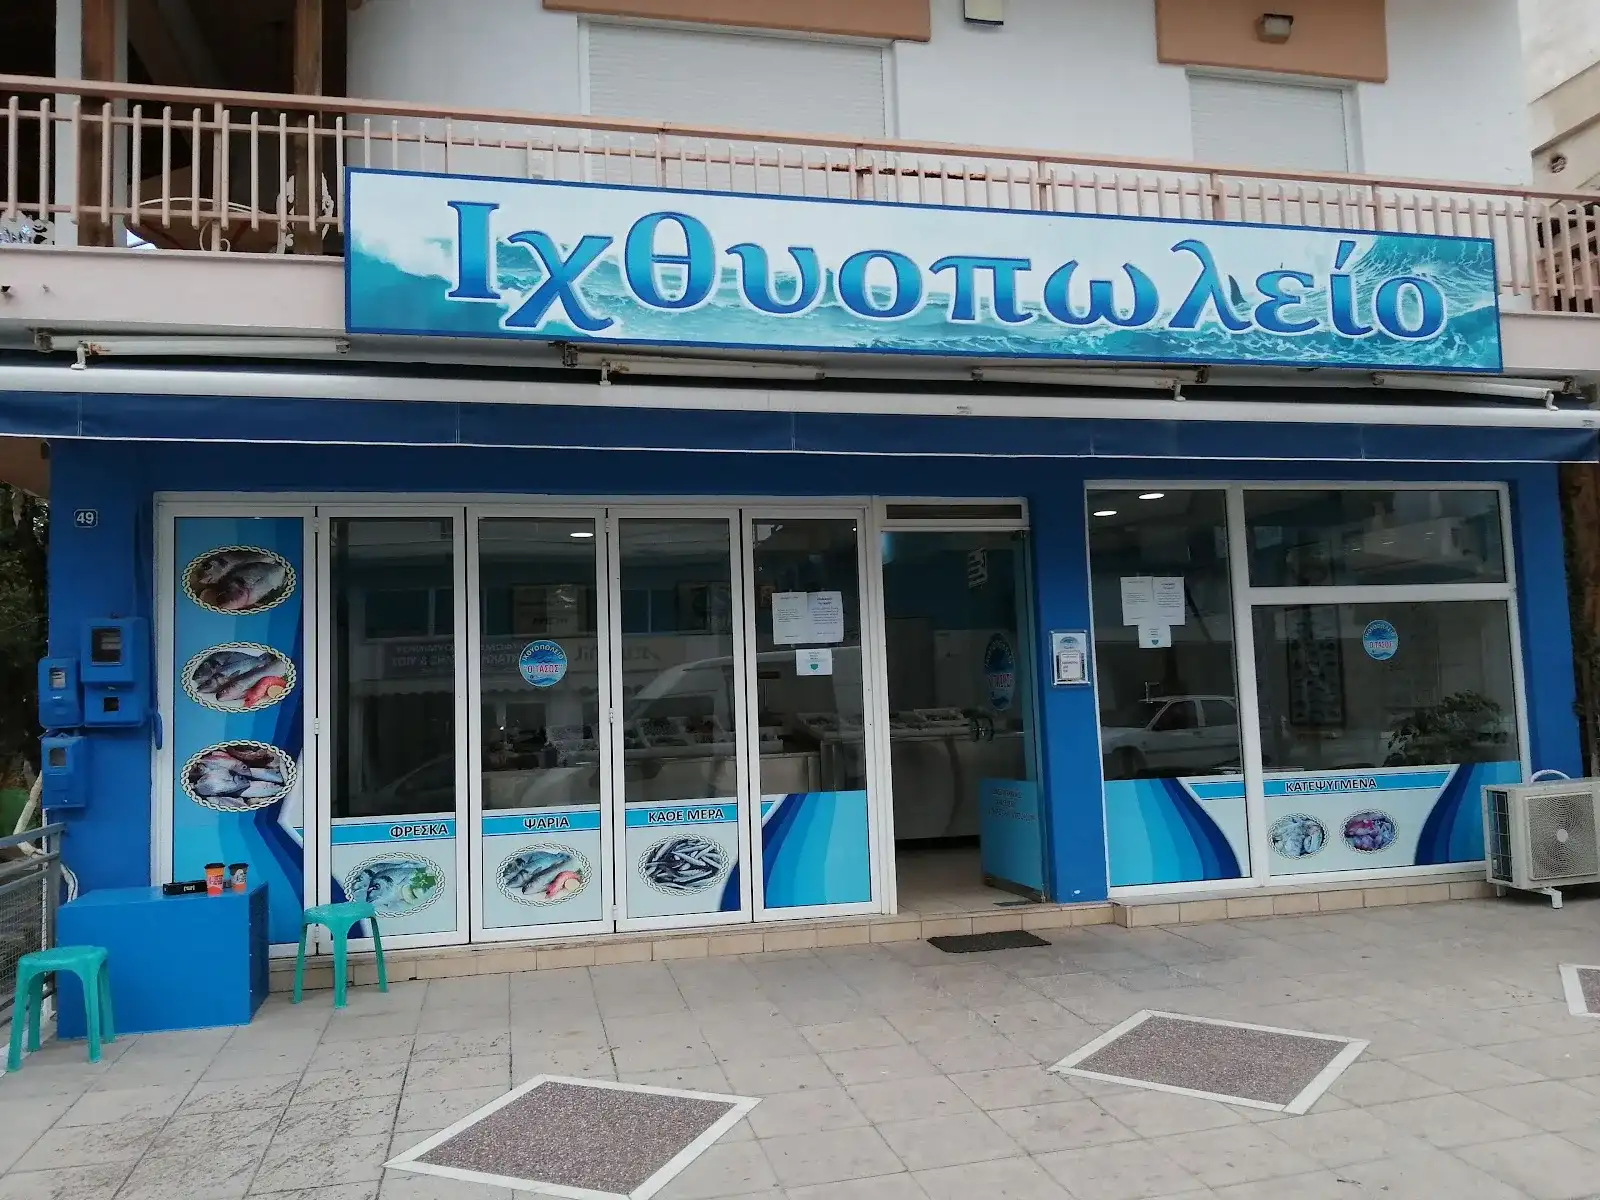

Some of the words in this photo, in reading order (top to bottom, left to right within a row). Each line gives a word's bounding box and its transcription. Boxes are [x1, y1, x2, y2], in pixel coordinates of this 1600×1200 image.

[446, 199, 1447, 339] Ιχθυοπωλείο
[77, 511, 94, 524] 49
[1285, 778, 1378, 793] ΚΑΤΕΨΥΓΜΕΝΑ
[524, 815, 569, 830] ΨΑΡΙΑ
[648, 810, 685, 824] ΚΑΘΕ
[687, 808, 725, 821] ΜΕΡΑ
[389, 822, 449, 838] ΦΡΕΣΚΑ
